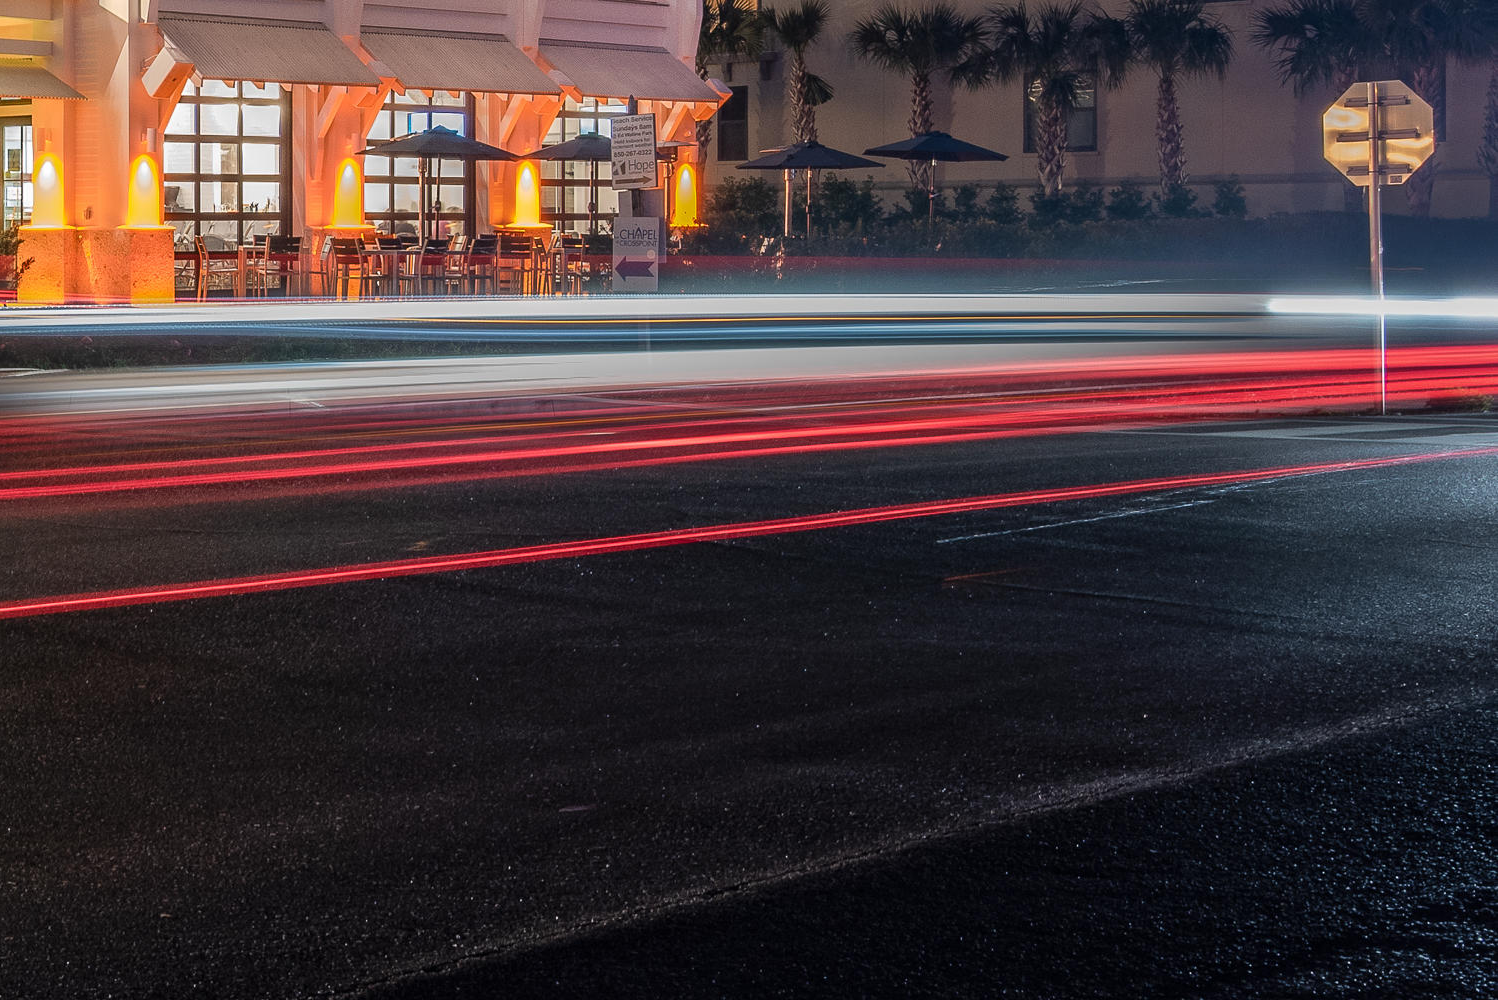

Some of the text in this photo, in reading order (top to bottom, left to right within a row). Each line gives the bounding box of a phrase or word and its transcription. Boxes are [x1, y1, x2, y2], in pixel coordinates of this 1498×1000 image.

[631, 115, 653, 123] Service
[628, 160, 655, 173] Hope
[619, 227, 658, 240] CHAPEL
